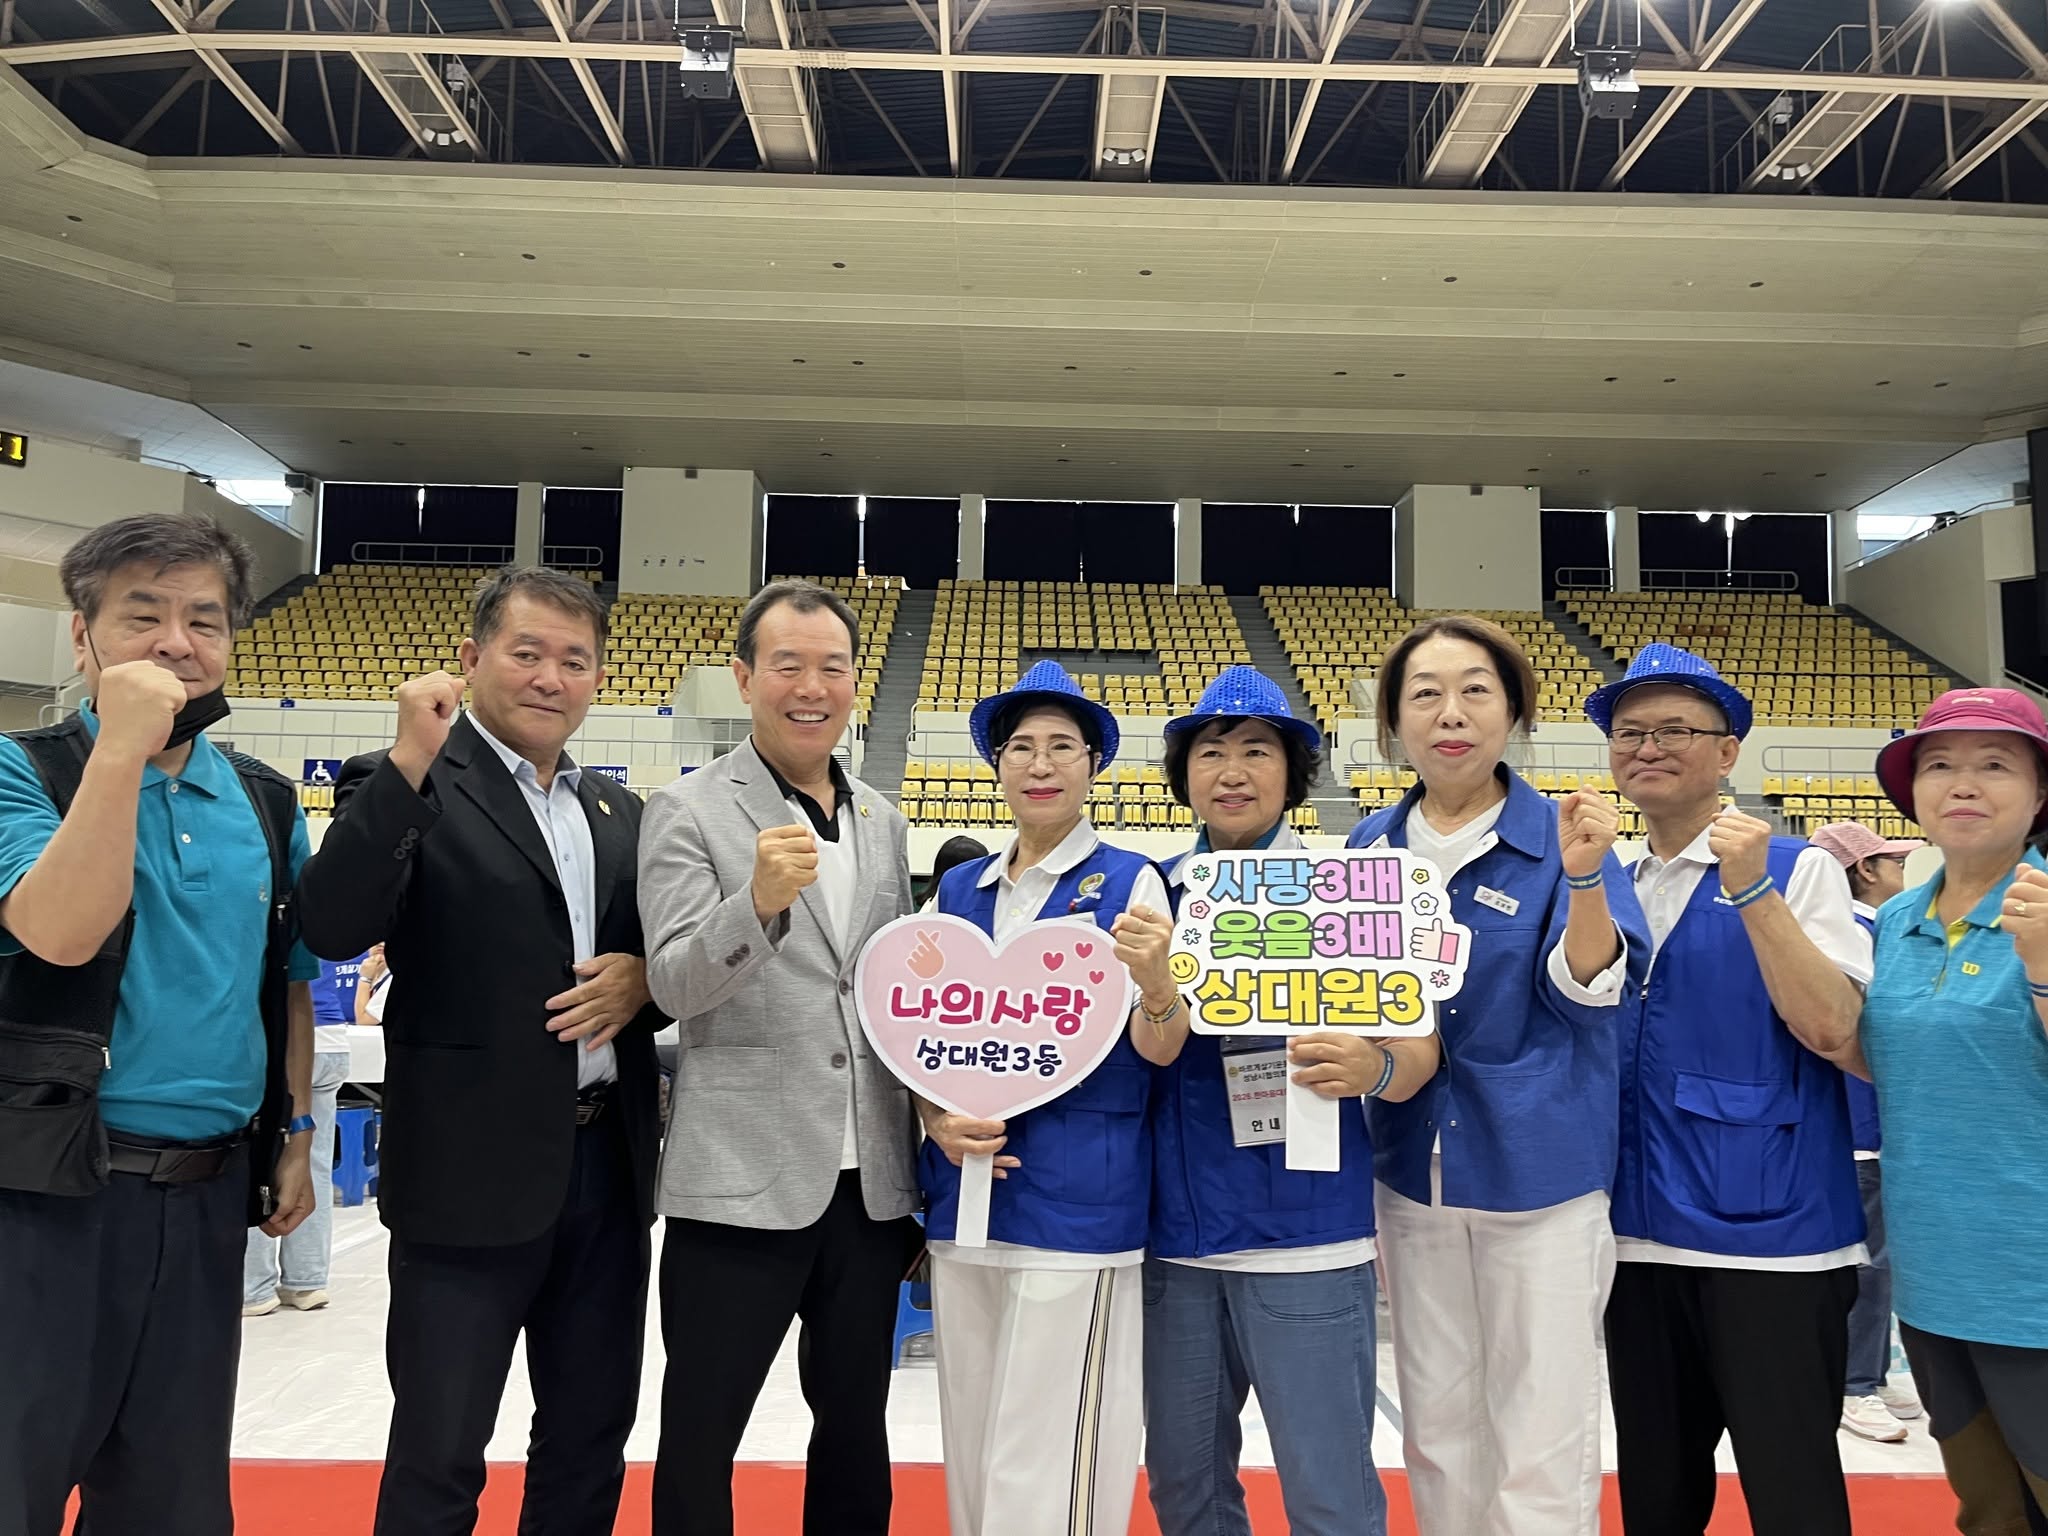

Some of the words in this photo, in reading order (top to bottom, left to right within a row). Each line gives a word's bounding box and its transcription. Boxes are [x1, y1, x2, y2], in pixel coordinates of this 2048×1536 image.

[1207, 857, 1403, 906] 사랑3배
[1210, 910, 1404, 960] 웃음3배
[1193, 967, 1425, 1027] 상대원3
[916, 1038, 1062, 1077] 상대원3동
